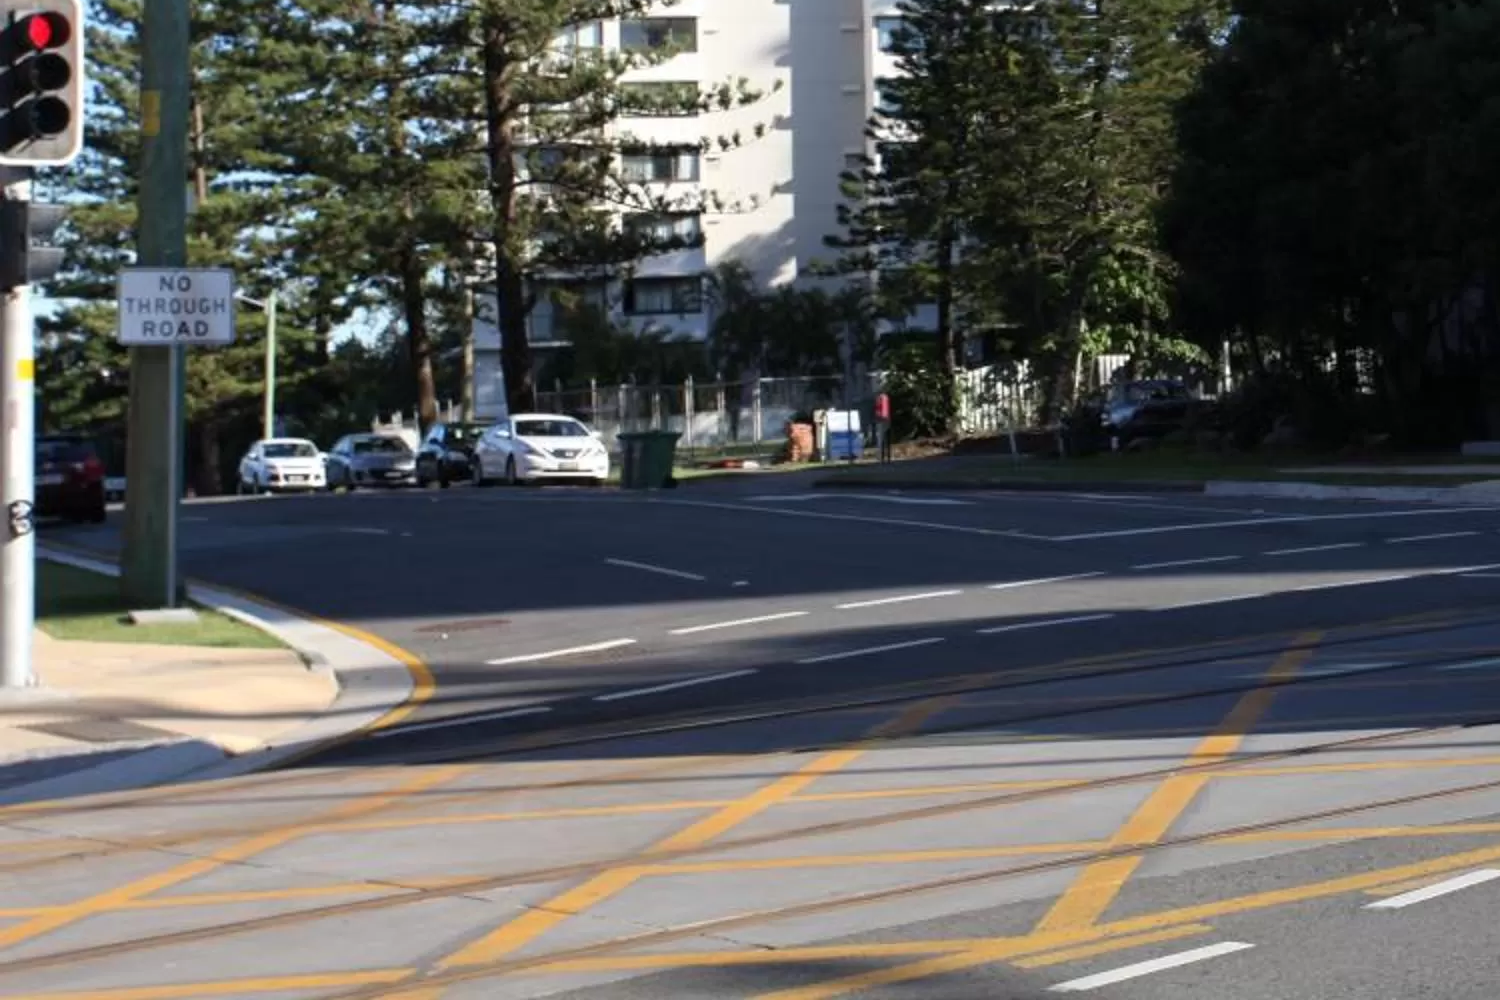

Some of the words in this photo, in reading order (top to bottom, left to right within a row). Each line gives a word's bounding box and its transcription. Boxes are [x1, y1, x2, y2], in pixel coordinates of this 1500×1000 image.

[159, 275, 191, 292] NO
[125, 297, 226, 315] THROUGH
[142, 320, 209, 337] ROAD
